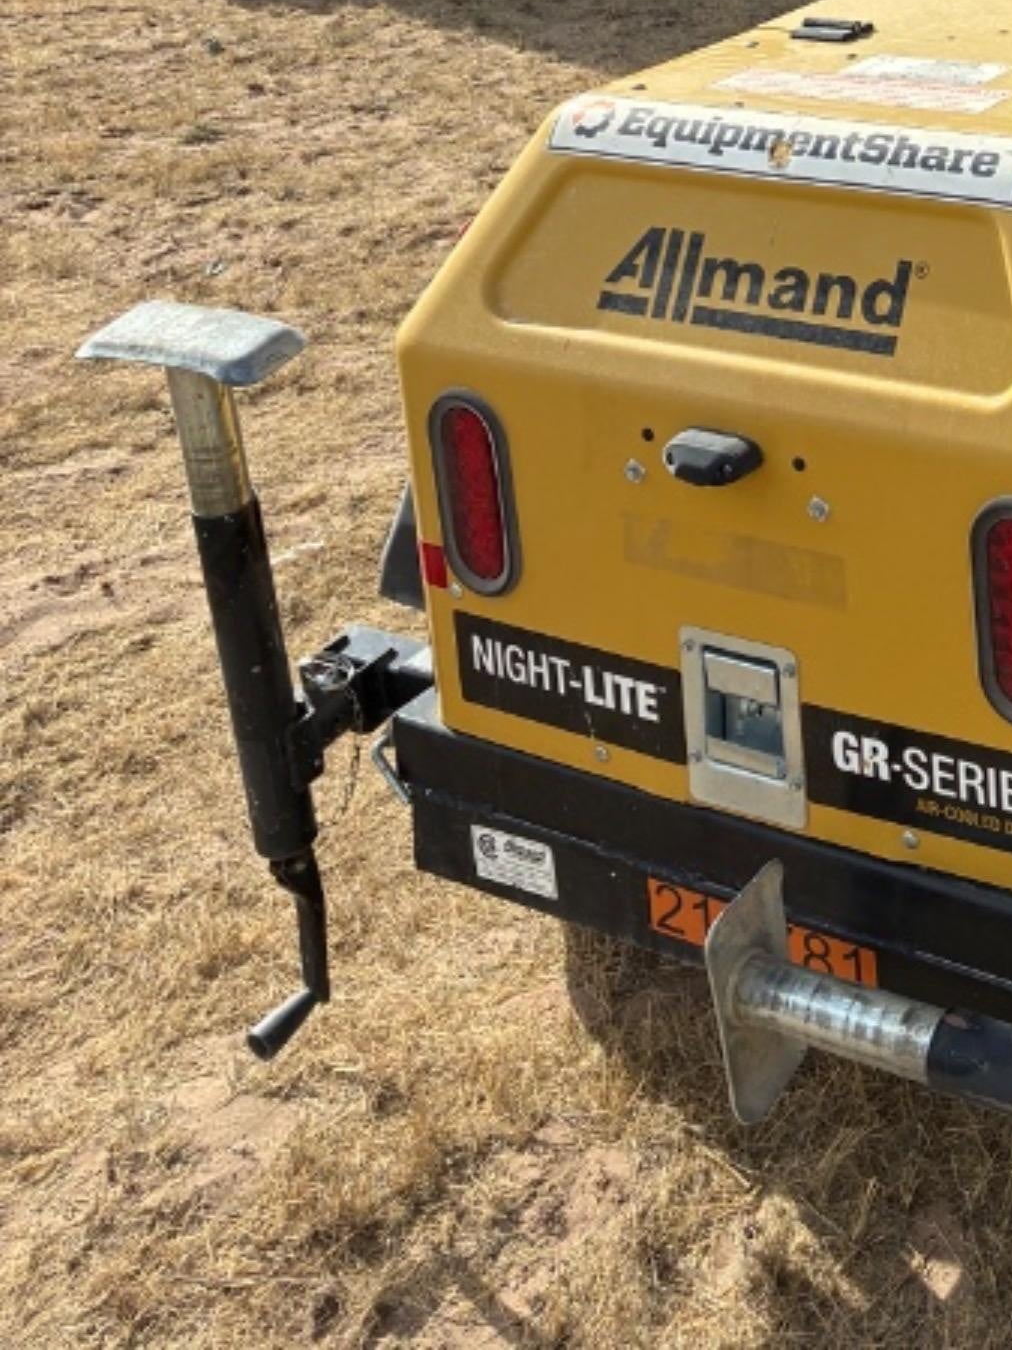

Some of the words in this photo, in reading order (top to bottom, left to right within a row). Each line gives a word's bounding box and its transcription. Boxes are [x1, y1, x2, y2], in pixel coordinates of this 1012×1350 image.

[617, 107, 1000, 178] EquipmentShare
[471, 634, 660, 722] NIGHT-LITE
[656, 883, 863, 983] 2181
